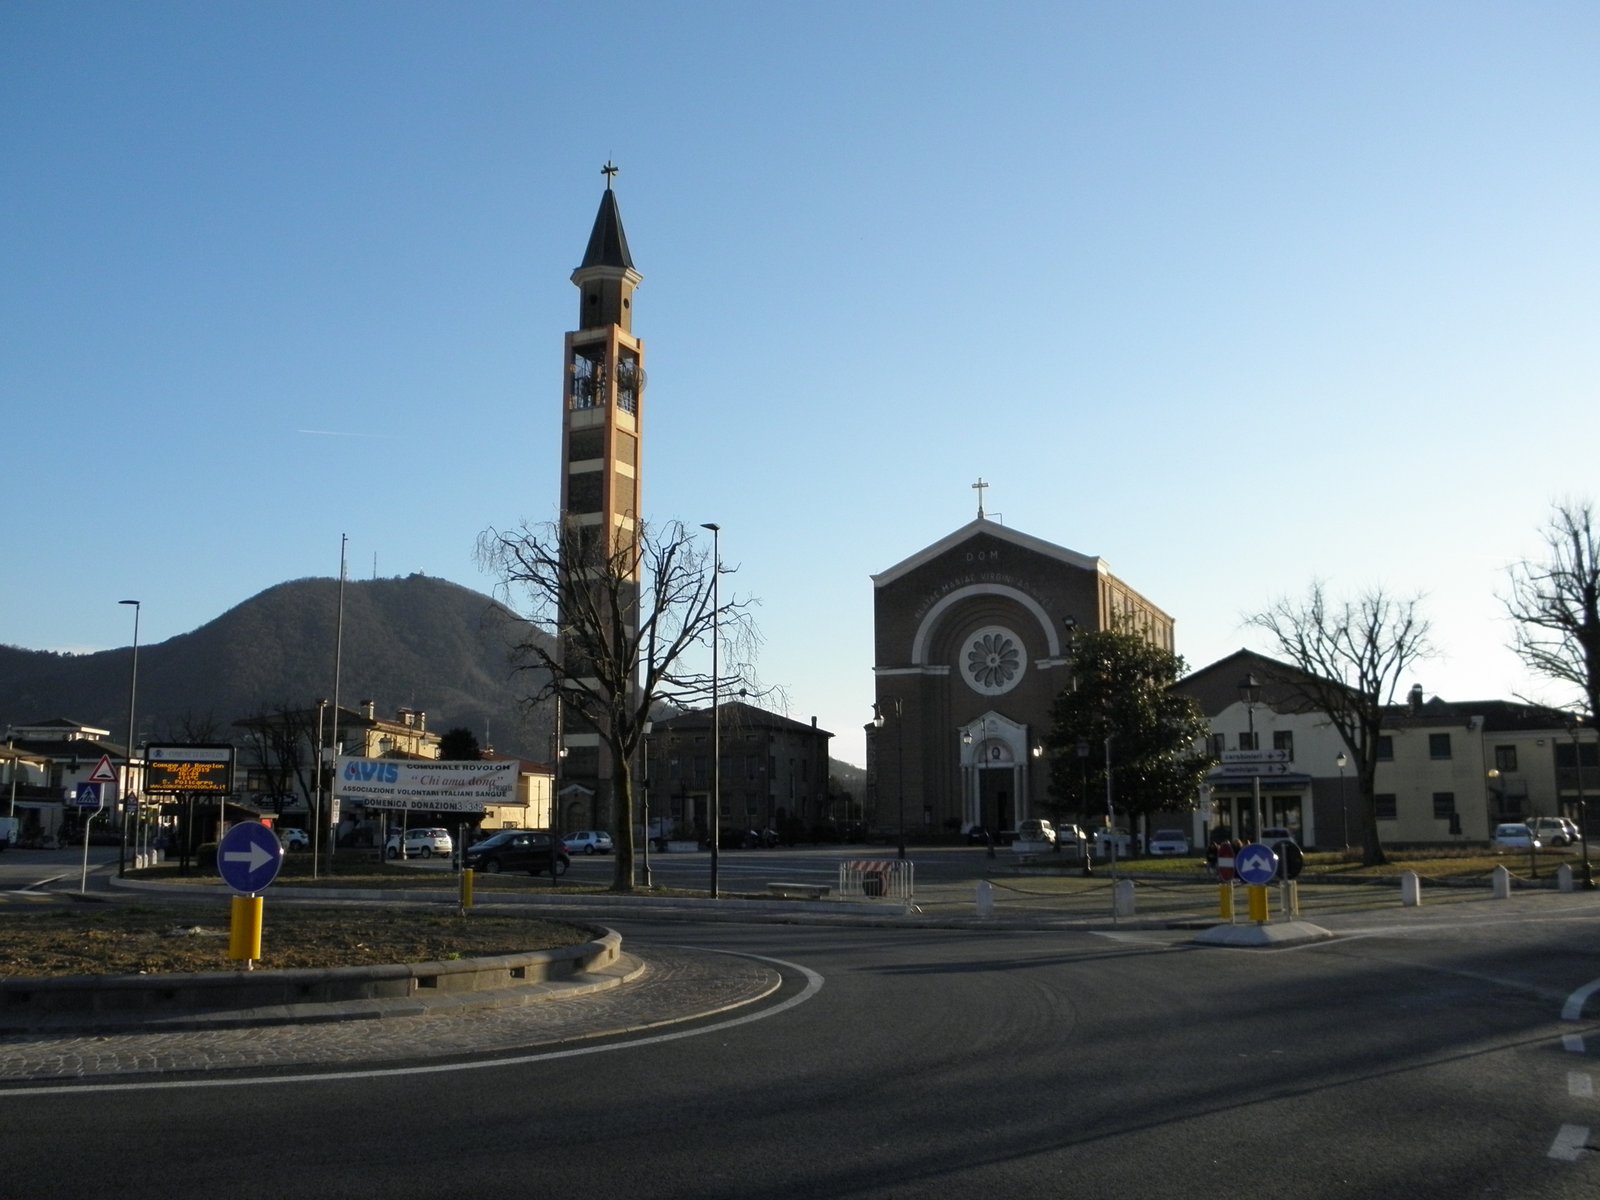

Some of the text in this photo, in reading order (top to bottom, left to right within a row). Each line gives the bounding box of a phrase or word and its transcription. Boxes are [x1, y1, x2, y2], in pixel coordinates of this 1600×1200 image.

[344, 761, 399, 784] AVIS
[407, 763, 460, 771] COMUNALE
[442, 778, 465, 786] ama
[342, 785, 395, 795] ASSOCIAZIONE
[397, 788, 440, 797] VOLONTARI
[364, 798, 408, 808] DOMENICA
[411, 800, 457, 811] DONAZIONI
